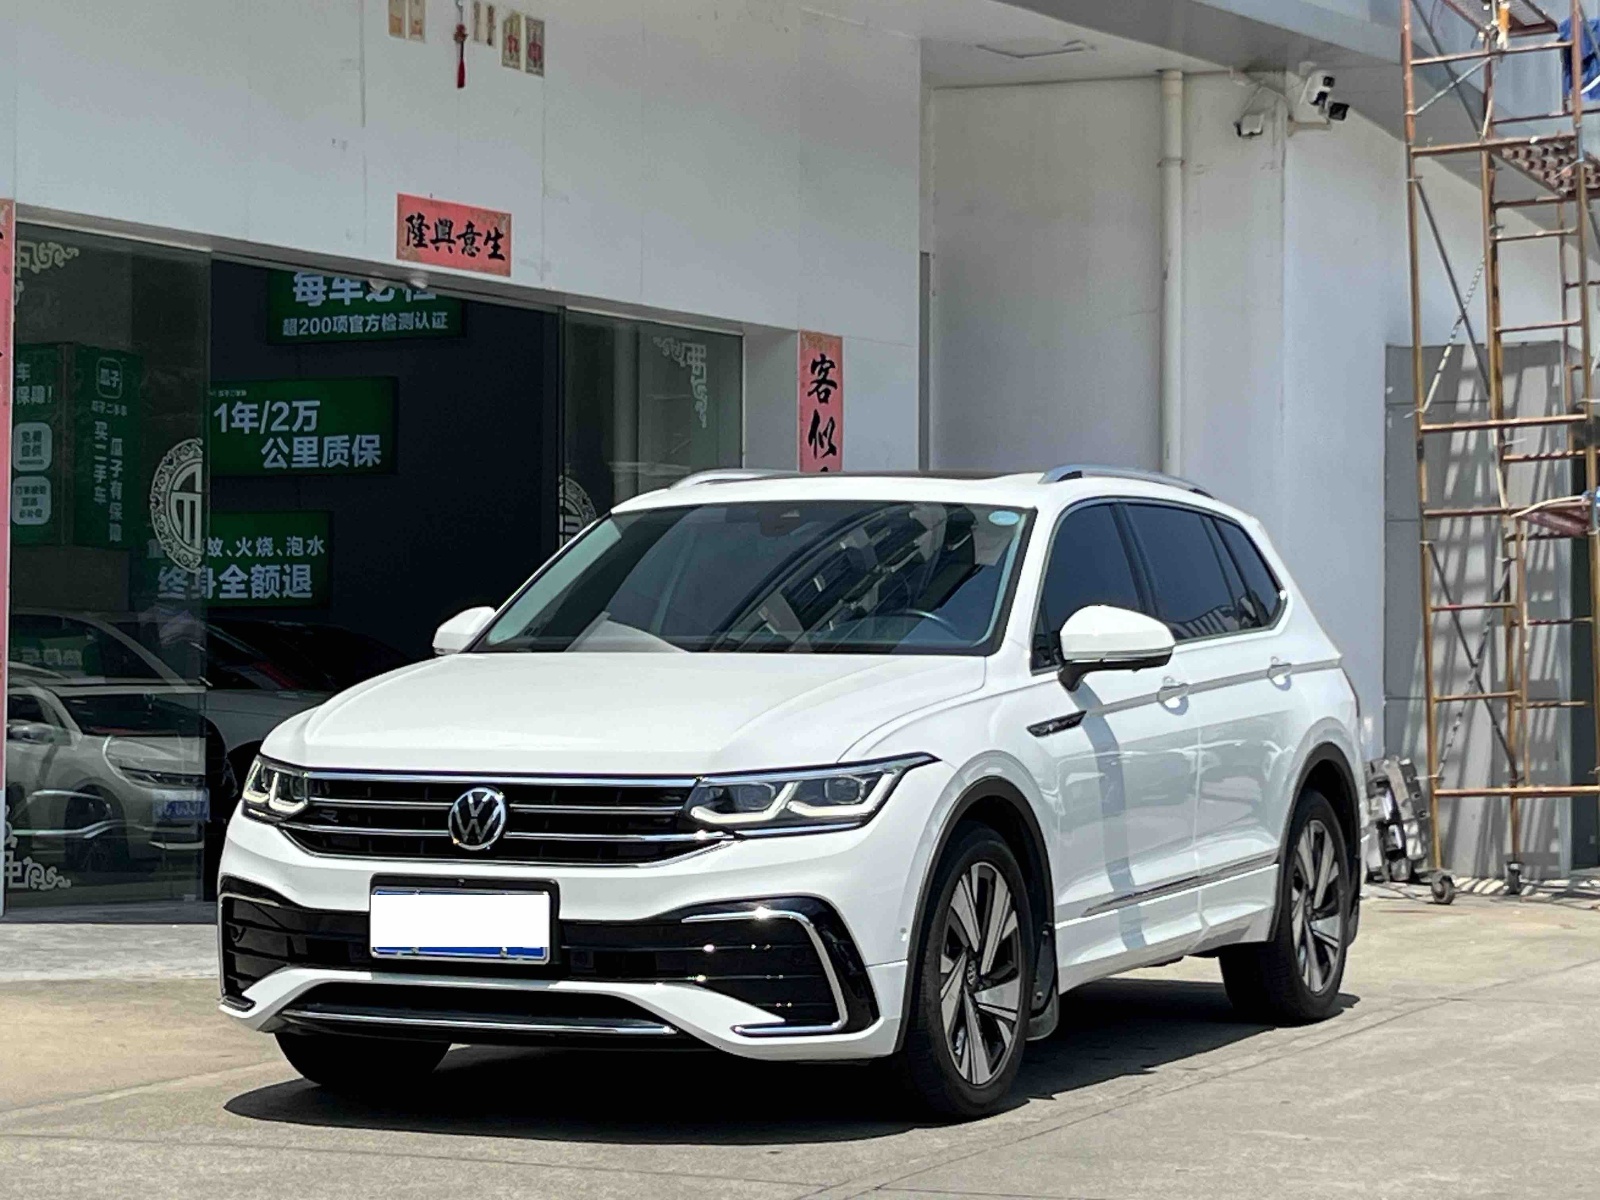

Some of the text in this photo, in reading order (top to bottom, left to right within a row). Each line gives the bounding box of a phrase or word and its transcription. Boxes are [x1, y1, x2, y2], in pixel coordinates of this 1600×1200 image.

[282, 311, 449, 337] 超200项官方检测认证
[213, 400, 321, 434] 1年/2万
[806, 353, 838, 471] 客似
[261, 434, 382, 469] 公里质保
[157, 563, 313, 600] 终身全额退
